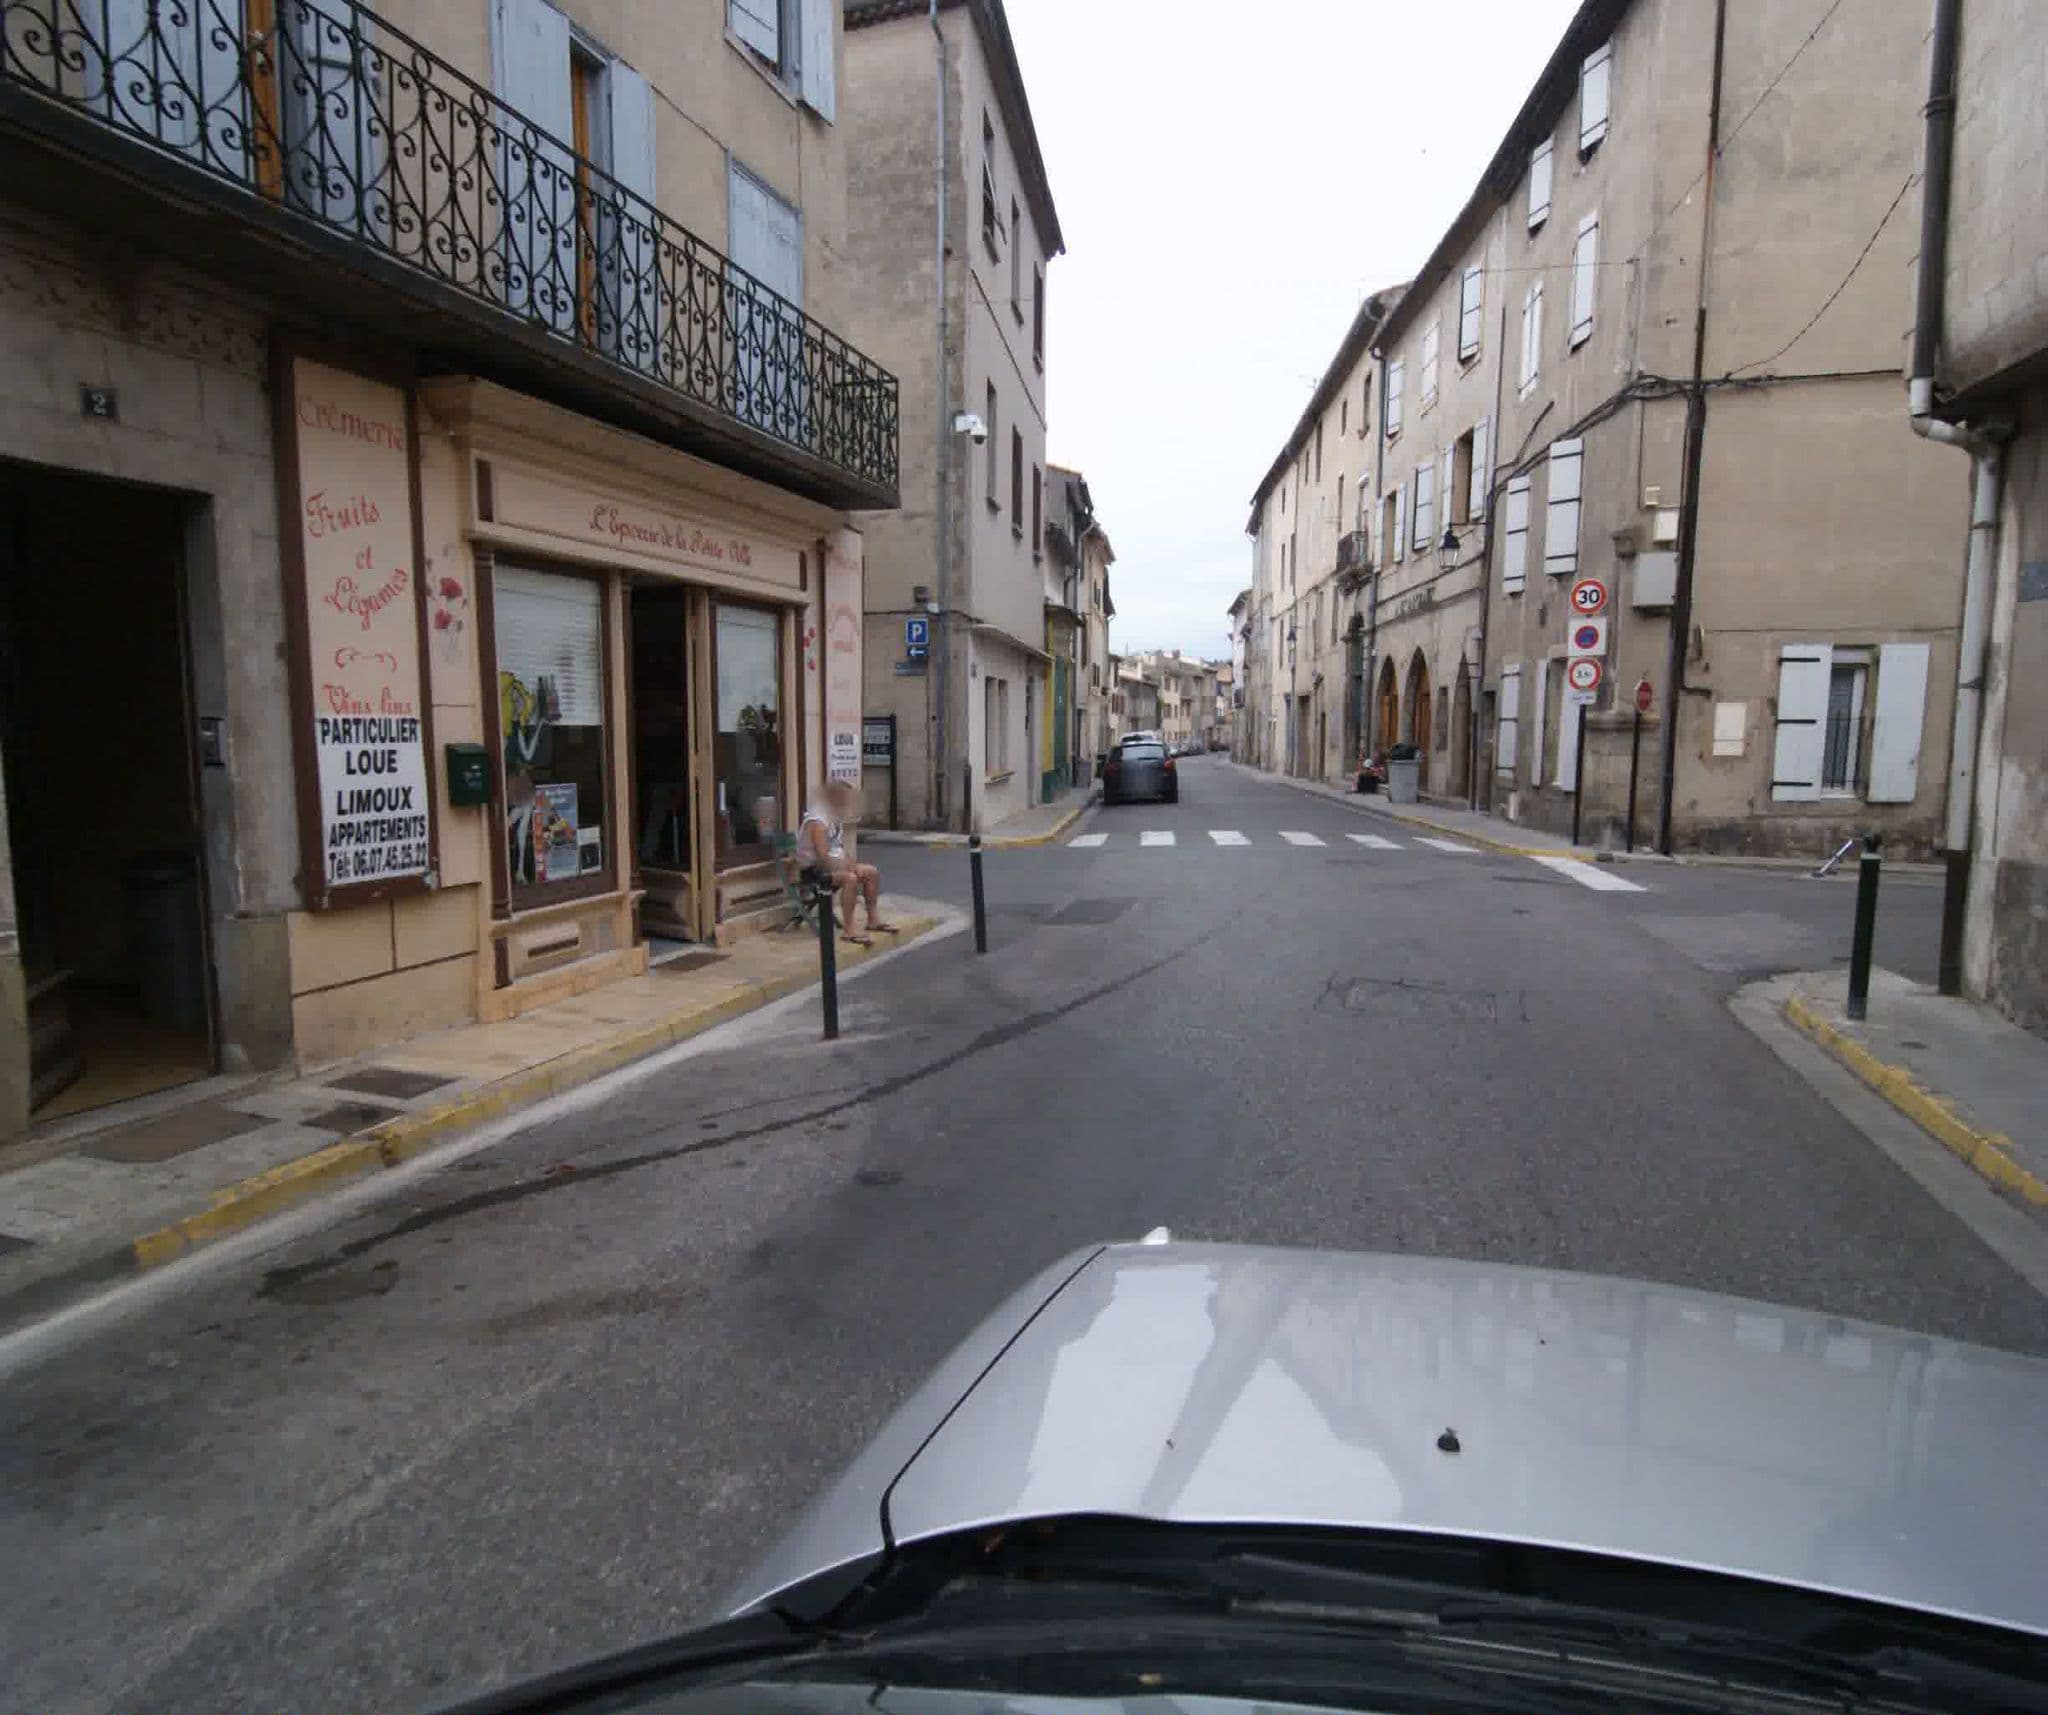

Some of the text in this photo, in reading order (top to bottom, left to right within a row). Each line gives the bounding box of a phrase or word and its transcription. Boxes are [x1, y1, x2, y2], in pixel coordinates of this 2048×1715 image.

[92, 392, 107, 415] 2
[306, 489, 379, 538] Fruits
[355, 546, 374, 570] et
[1578, 589, 1600, 604] 30
[912, 623, 922, 641] P
[320, 718, 418, 745] PARTICULIER
[345, 750, 398, 775] LOUE
[337, 786, 413, 815] LIMOUX
[328, 815, 426, 848] APPARTEMENTS
